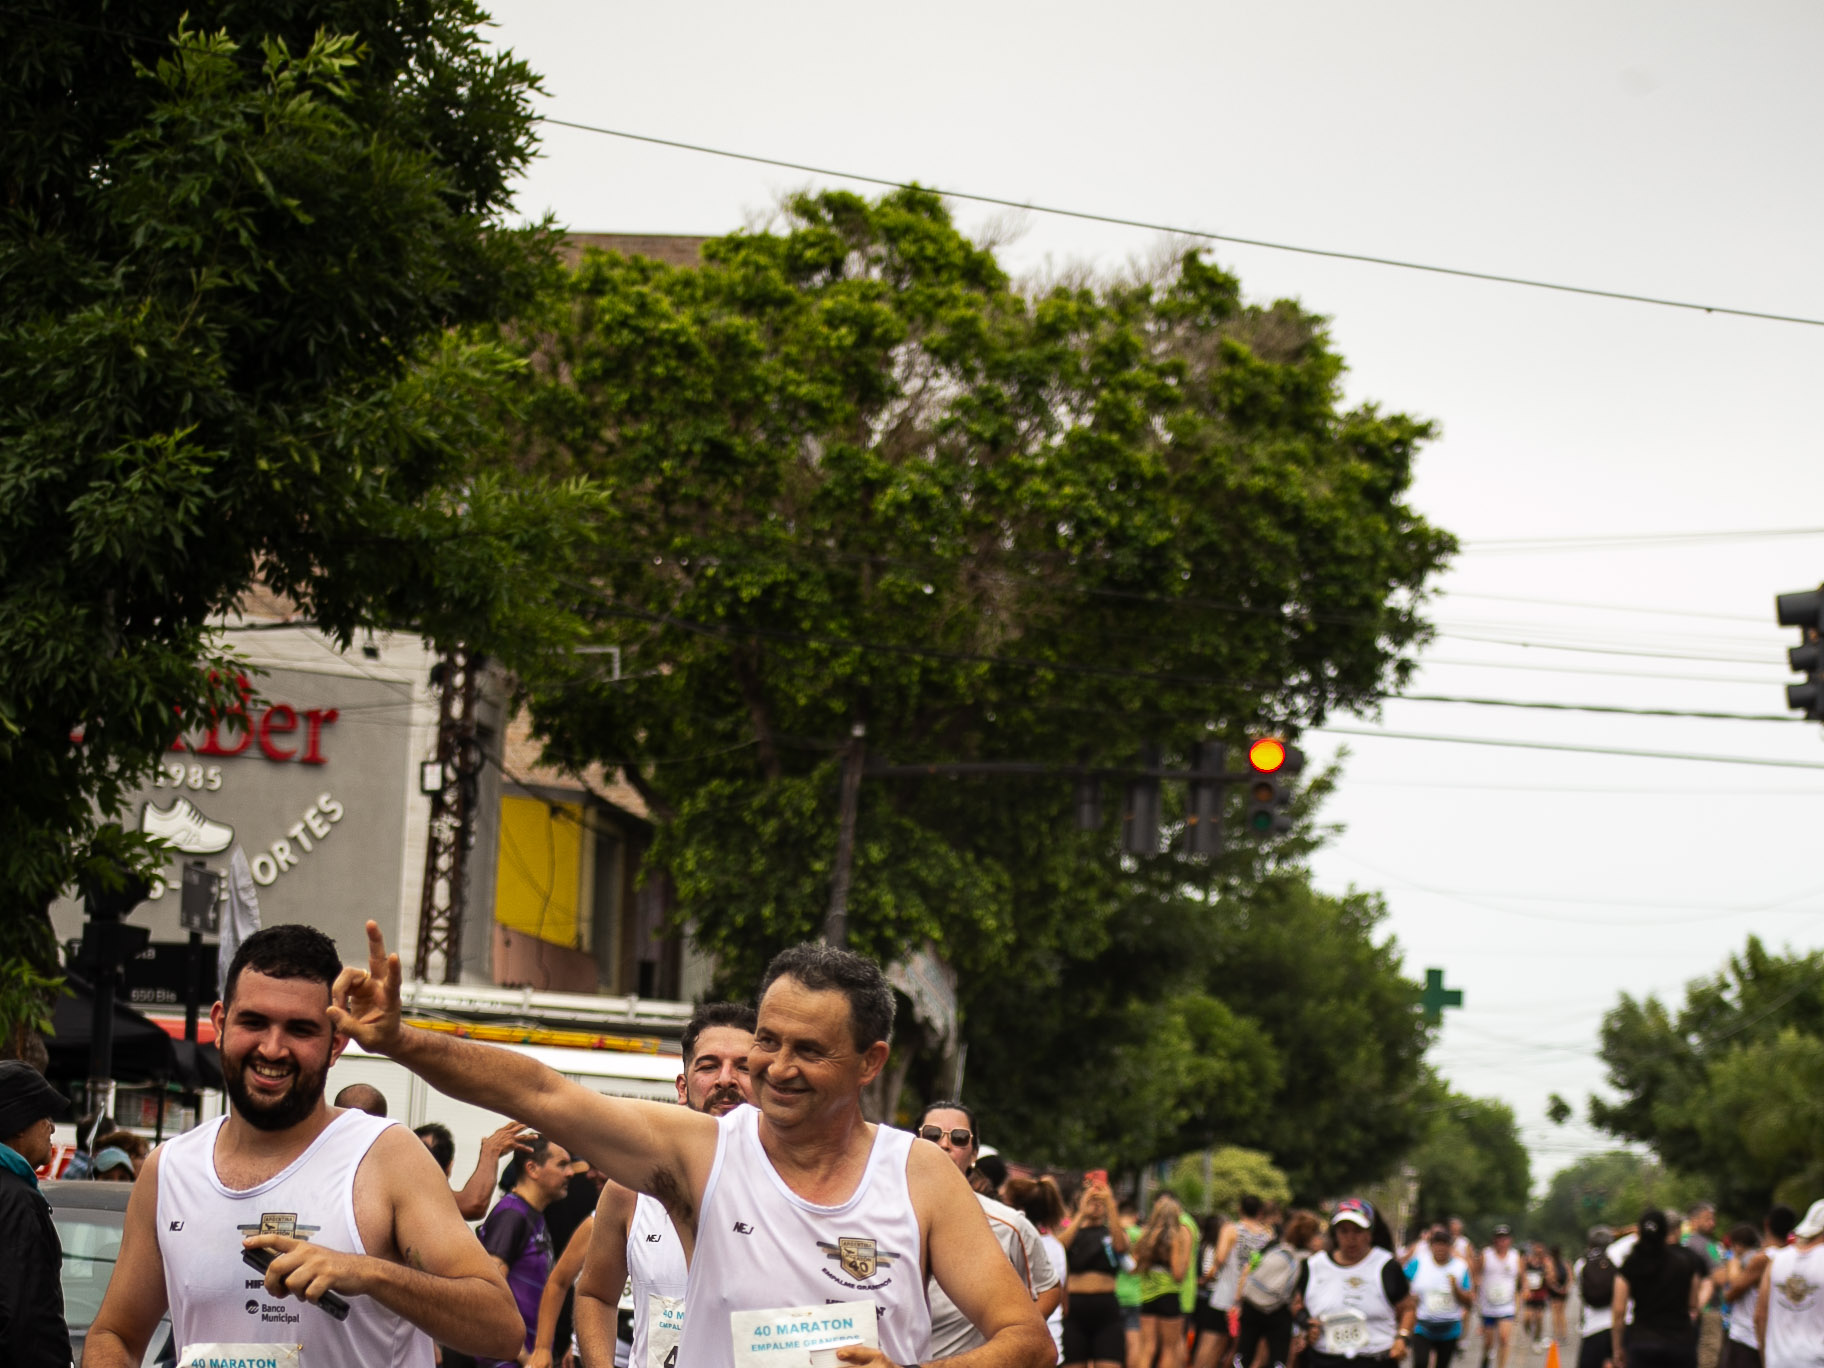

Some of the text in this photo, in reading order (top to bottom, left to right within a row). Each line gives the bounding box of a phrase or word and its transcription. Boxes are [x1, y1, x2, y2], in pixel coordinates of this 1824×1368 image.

[219, 792, 344, 901] ORTES
[169, 1221, 185, 1232] NEJ
[733, 1222, 754, 1235] NEJ
[646, 1234, 662, 1243] NEJ
[848, 1260, 869, 1273] 40
[822, 1267, 855, 1289] EMPALME
[262, 1304, 285, 1313] Banco
[663, 1309, 673, 1319] 40
[262, 1313, 300, 1325] Municipal
[659, 1321, 682, 1331] EMPAL
[754, 1318, 853, 1336] 40 MARATON
[751, 1340, 800, 1352] EMPALME
[191, 1358, 277, 1368] 40 MARATON
